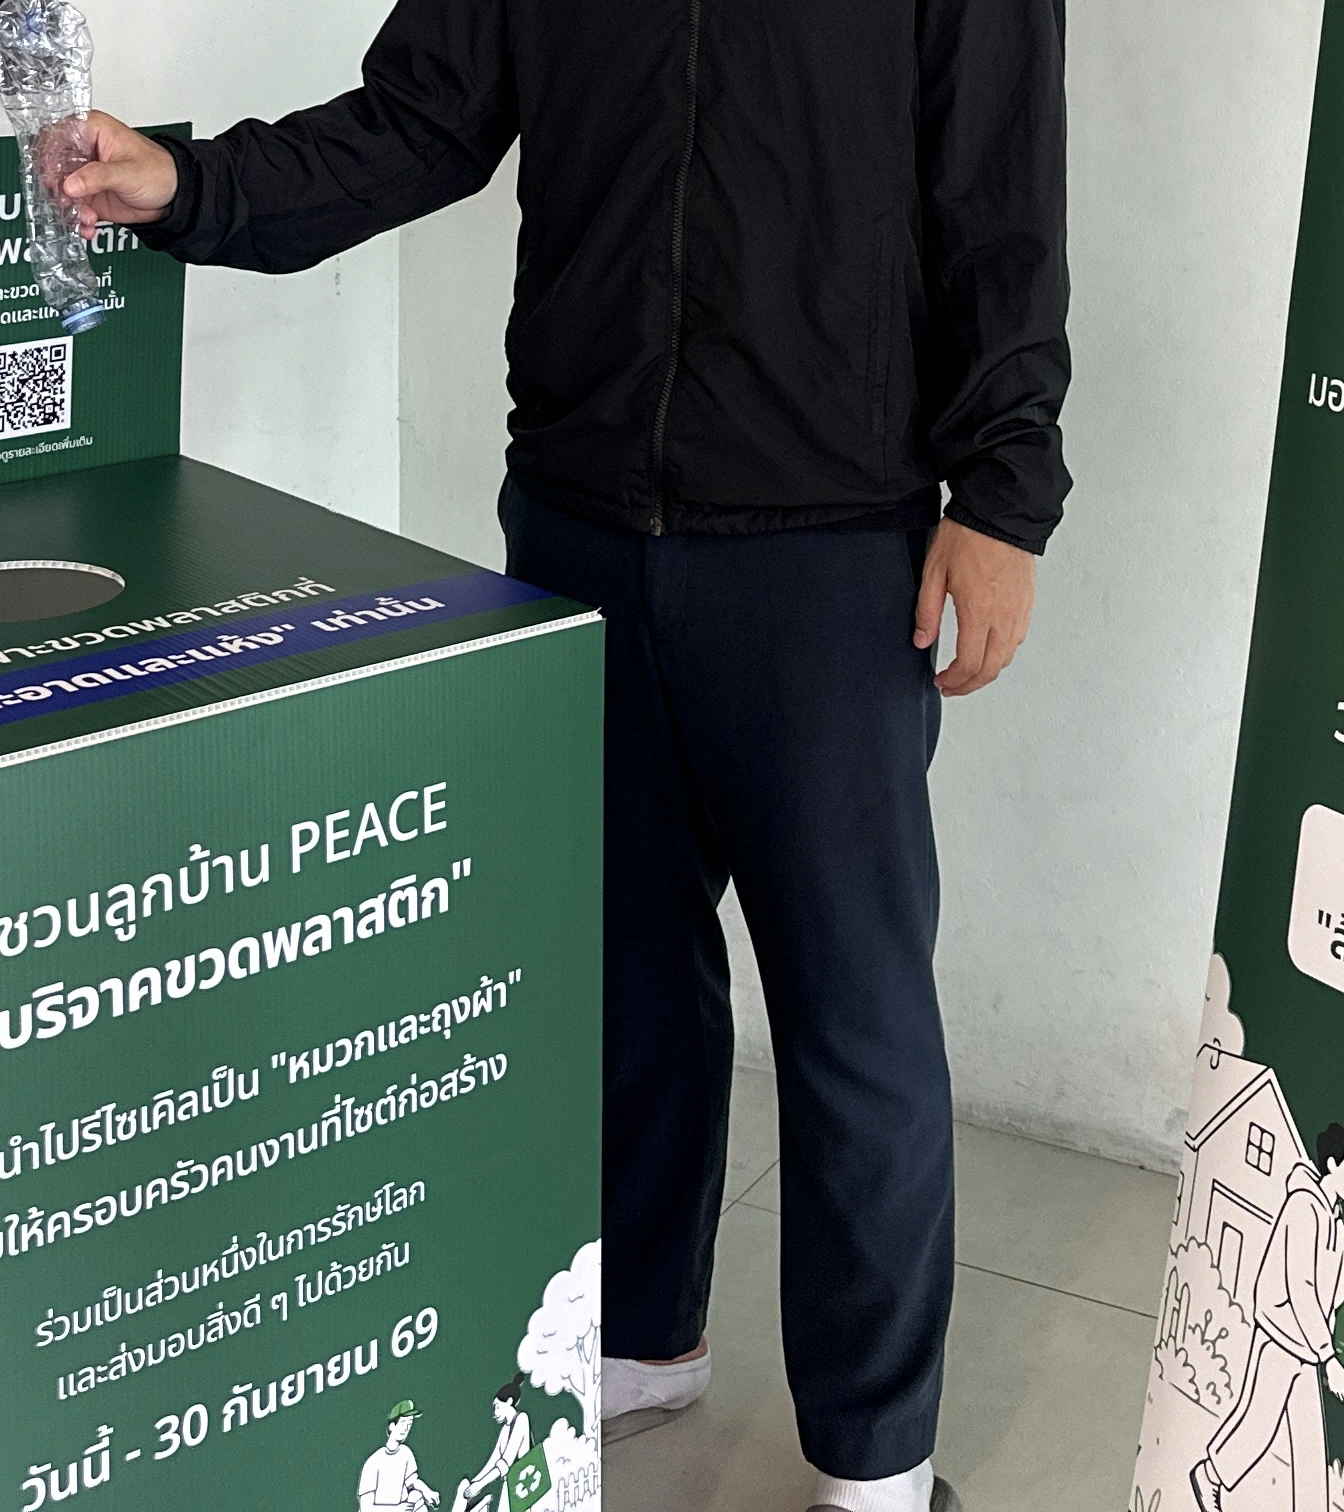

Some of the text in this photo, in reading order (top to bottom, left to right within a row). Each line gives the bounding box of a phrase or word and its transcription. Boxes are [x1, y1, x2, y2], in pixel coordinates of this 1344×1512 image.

[310, 597, 446, 632] เท่านั้น
[291, 781, 447, 874] PEACE
[271, 968, 522, 1084] "หมวกและถุงผ้า"
[36, 1180, 425, 1347] ร่วมเป็นส่วนหนึ่งในการรักษ์โลก
[58, 1294, 261, 1400] และส่งมอบสิ่งดี
[294, 1241, 410, 1308] ไปด้วยกัน
[21, 1307, 438, 1512] วันนี้ - 30 กันยายน 69
